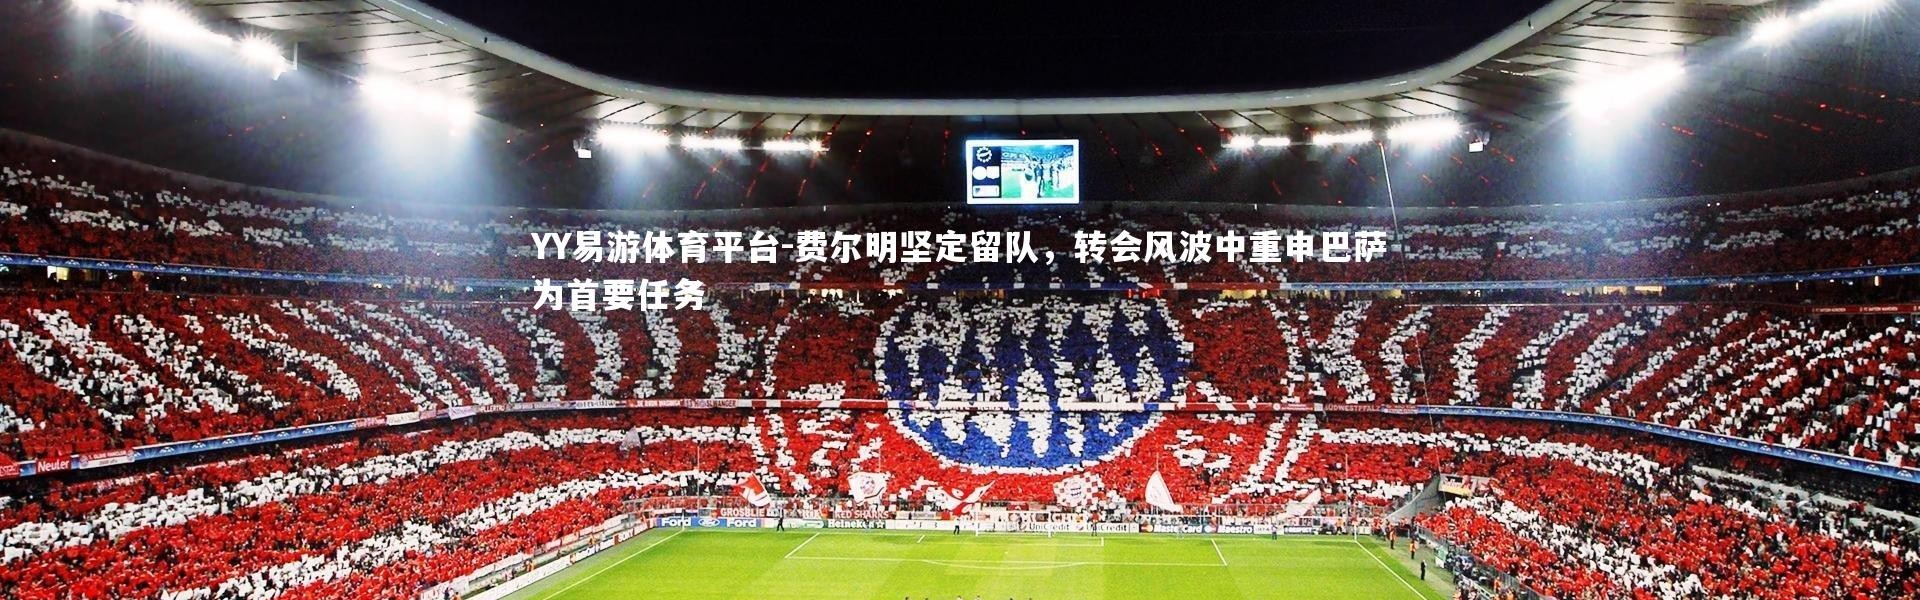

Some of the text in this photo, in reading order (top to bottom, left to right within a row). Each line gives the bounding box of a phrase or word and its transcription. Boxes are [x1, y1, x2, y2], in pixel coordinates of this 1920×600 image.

[855, 510, 889, 520] SHARKS
[661, 517, 692, 527] Ford
[726, 518, 757, 528] Ford
